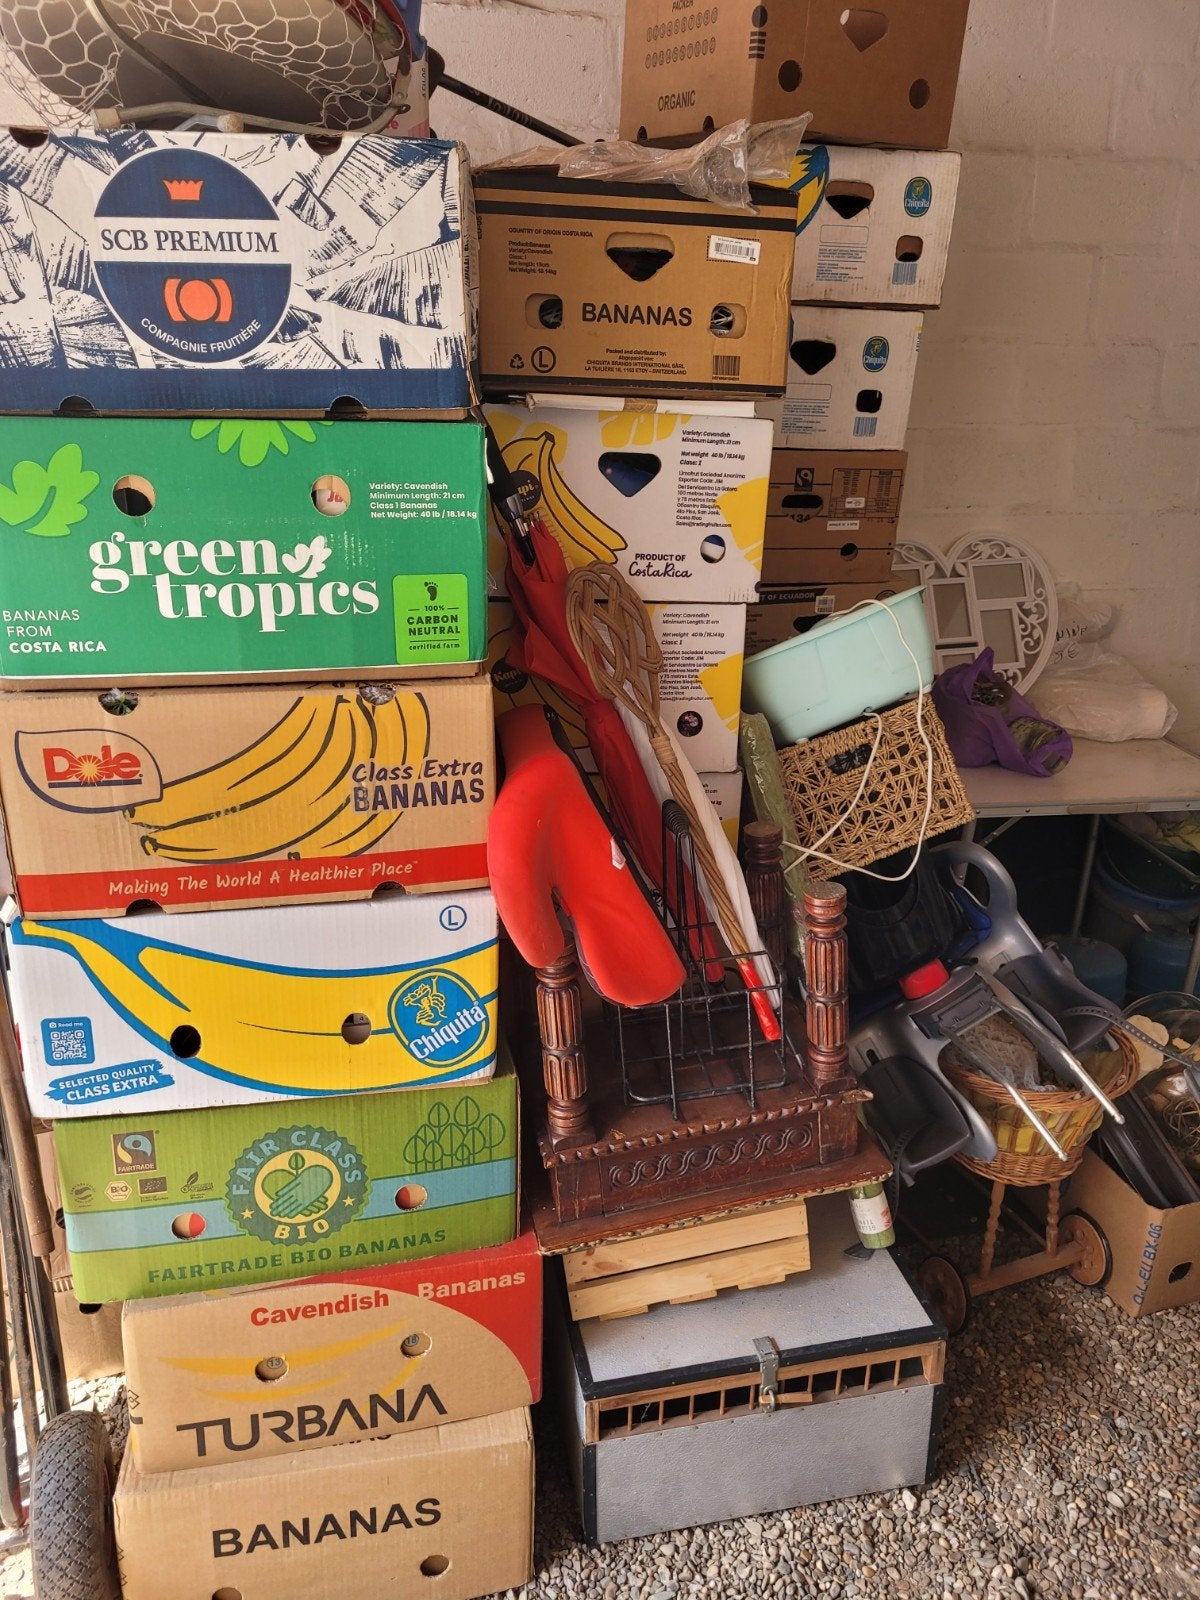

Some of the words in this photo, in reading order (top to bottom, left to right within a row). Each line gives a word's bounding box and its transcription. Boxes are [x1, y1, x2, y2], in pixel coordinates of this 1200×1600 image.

[658, 90, 696, 112] ORGANIC
[508, 227, 535, 235] COUNTRY
[101, 228, 148, 256] SCB
[154, 230, 280, 258] PREMIUM
[581, 302, 693, 328] BANANAS
[141, 317, 208, 358] COMPAGNIE
[210, 320, 262, 357] FRUITIÈRE
[537, 350, 549, 368] L
[682, 430, 703, 438] Variety:
[707, 438, 727, 446] Length:
[691, 451, 709, 459] weight
[369, 482, 402, 491] Variety:
[403, 482, 448, 490] Cavendish
[369, 492, 410, 500] Minimum
[411, 492, 442, 501] Length:
[386, 511, 419, 520] Weight:
[432, 510, 441, 518] lb
[446, 510, 466, 518] 18.14
[466, 510, 478, 519] kg
[88, 531, 283, 597] green
[635, 552, 672, 562] PRODUCT
[673, 553, 687, 562] OF
[628, 561, 663, 578] Costa
[662, 561, 692, 579] Rica
[151, 571, 380, 634] tropics
[779, 592, 816, 601] ECUADOR
[2, 608, 81, 624] BANANAS
[406, 614, 459, 625] CARBON
[7, 625, 53, 638] FROM
[408, 626, 460, 636] NEUTRAL
[9, 640, 64, 655] COSTA
[68, 640, 107, 653] RICA
[409, 642, 441, 651] certified
[42, 745, 141, 784] Dole
[353, 762, 413, 783] Class
[421, 758, 484, 778] Extra
[352, 778, 486, 814] BANANAS
[108, 880, 170, 898] Making
[177, 874, 208, 890] The
[215, 871, 260, 888] World
[269, 869, 281, 884] A
[288, 863, 365, 883] Healthier
[370, 861, 413, 877] Place
[448, 909, 459, 926] L
[409, 1004, 487, 1060] Chiquita
[59, 1074, 109, 1090] SELECTED
[111, 1064, 155, 1082] QUALITY
[66, 1086, 112, 1101] CLASS
[113, 1075, 158, 1092] EXTRA
[117, 1162, 155, 1174] FAIRTRADE
[231, 1138, 279, 1196] FAIR
[290, 1129, 362, 1184] CLASS
[273, 1218, 328, 1241] BIO
[148, 1254, 282, 1284] FAIRTRADE
[290, 1246, 333, 1264] BIO
[338, 1230, 447, 1259] BANANAS
[417, 1270, 527, 1300] Bananas
[250, 1290, 389, 1326] Cavendish
[176, 1384, 448, 1458] TURBANA
[212, 1497, 442, 1559] BANANAS
